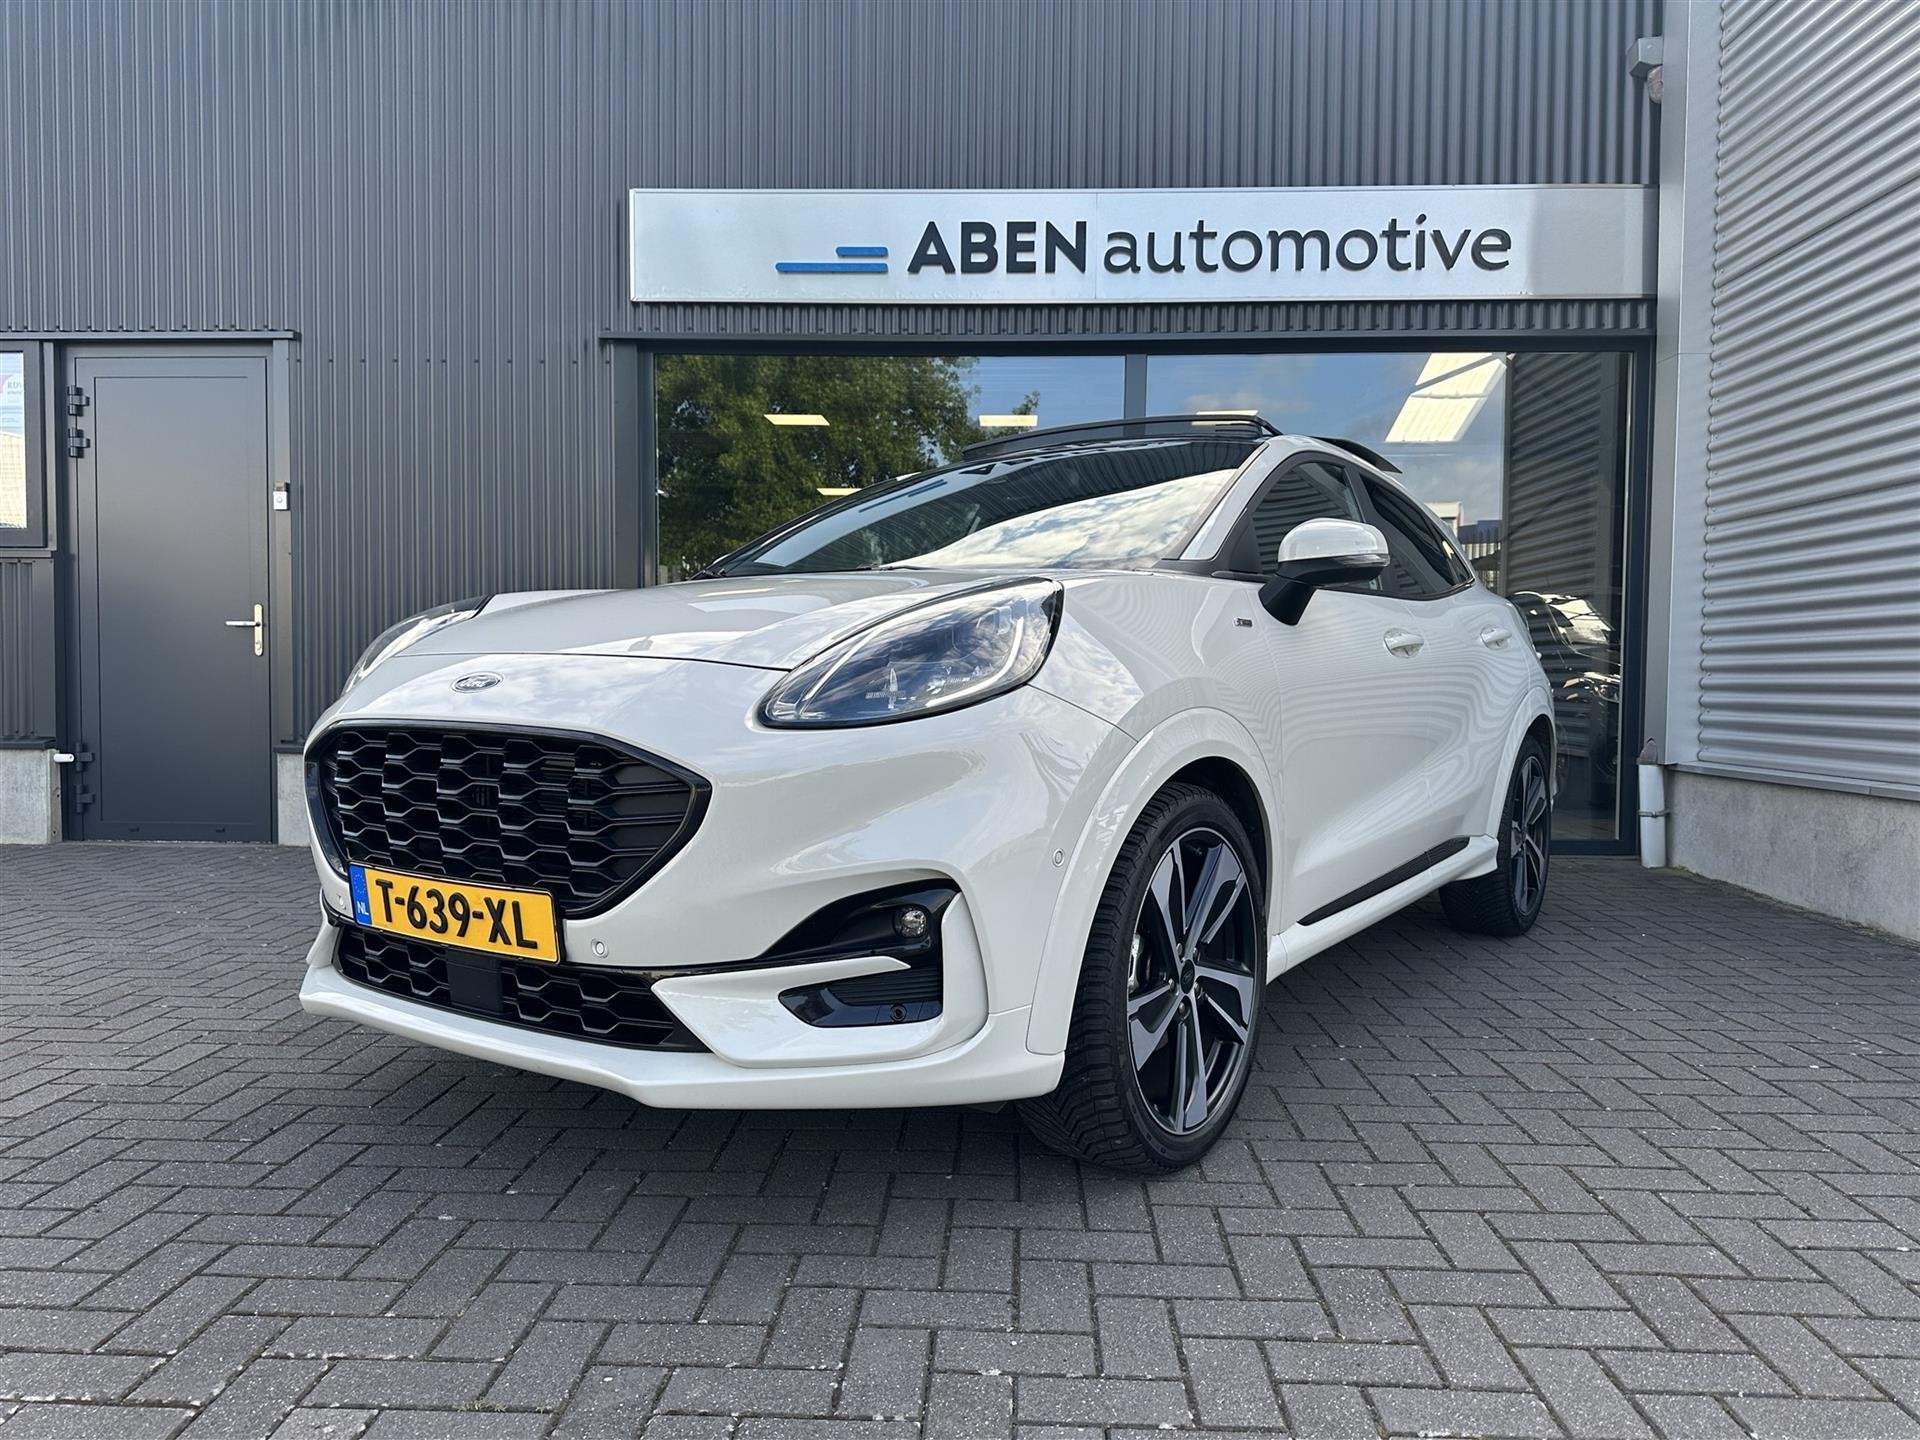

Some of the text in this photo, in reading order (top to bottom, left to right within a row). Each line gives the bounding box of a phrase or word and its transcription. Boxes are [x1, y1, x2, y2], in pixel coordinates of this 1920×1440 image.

[907, 213, 1512, 274] ABEN automotive
[356, 902, 369, 916] NL
[375, 878, 538, 950] T-639-XL
